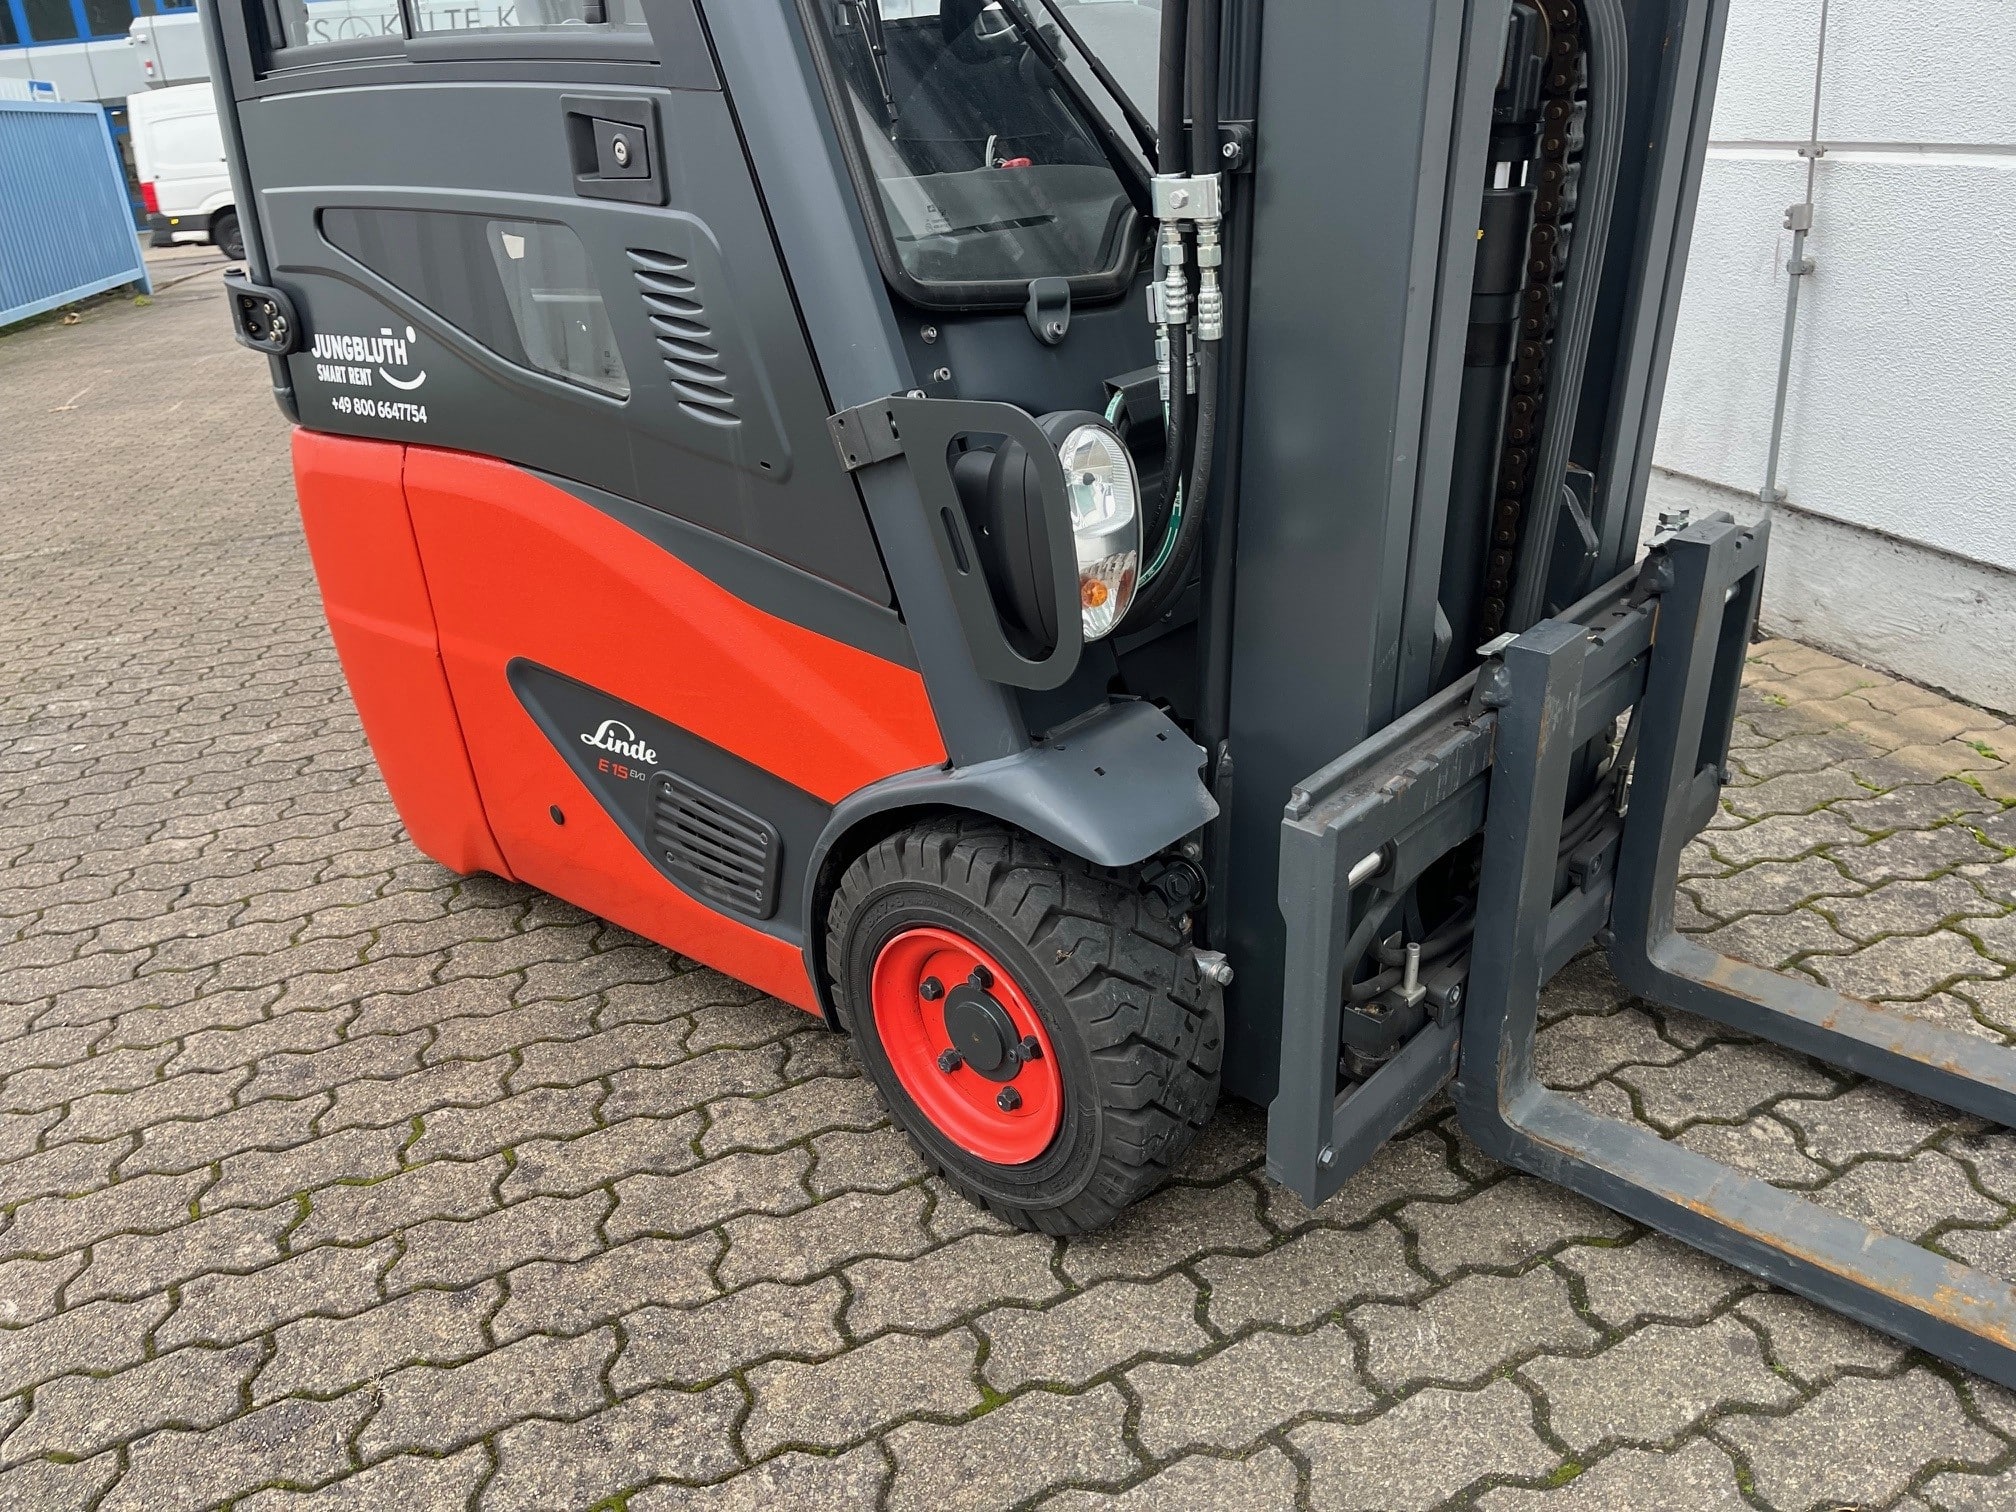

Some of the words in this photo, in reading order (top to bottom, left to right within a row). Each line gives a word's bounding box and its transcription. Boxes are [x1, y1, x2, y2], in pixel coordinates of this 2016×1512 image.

[316, 363, 347, 384] SMART
[347, 366, 373, 387] RENT
[331, 396, 352, 414] +49
[353, 397, 376, 417] 800
[377, 400, 428, 423] 6647754
[580, 719, 658, 765] Linde
[598, 758, 610, 774] E
[611, 762, 629, 780] 15
[629, 769, 646, 782] EVO
